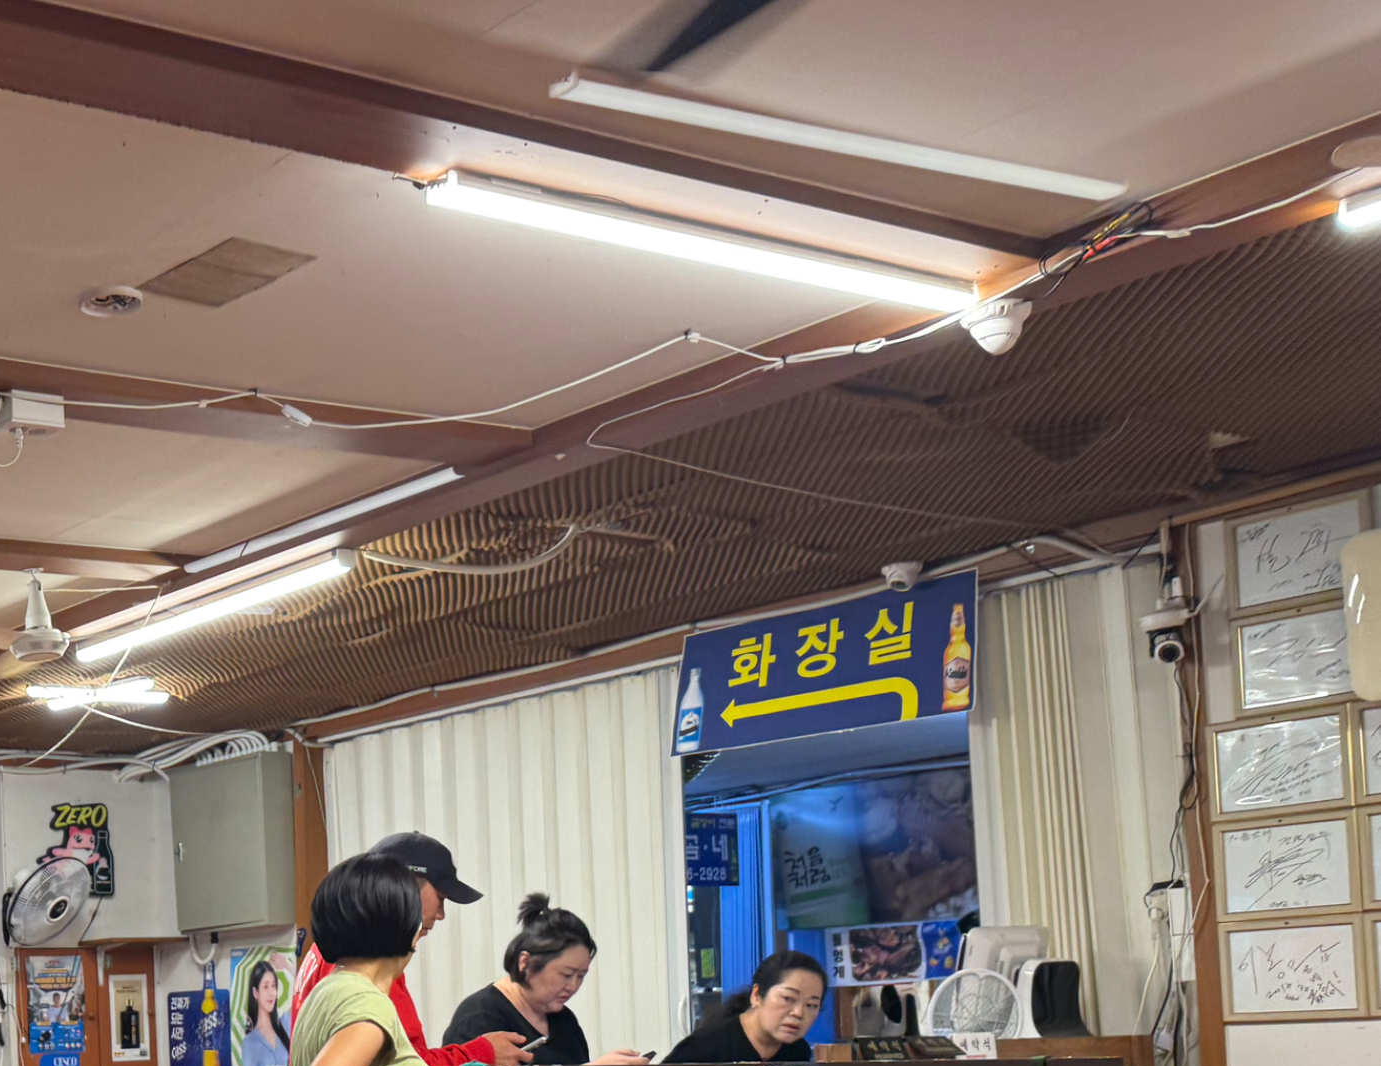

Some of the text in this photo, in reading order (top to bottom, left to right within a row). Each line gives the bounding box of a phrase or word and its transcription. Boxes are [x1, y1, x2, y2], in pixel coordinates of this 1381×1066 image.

[728, 601, 914, 688] 화장실
[53, 803, 107, 829] ZERO
[783, 846, 823, 871] 처음
[787, 868, 831, 888] 처럼
[171, 1027, 184, 1041] 시간
